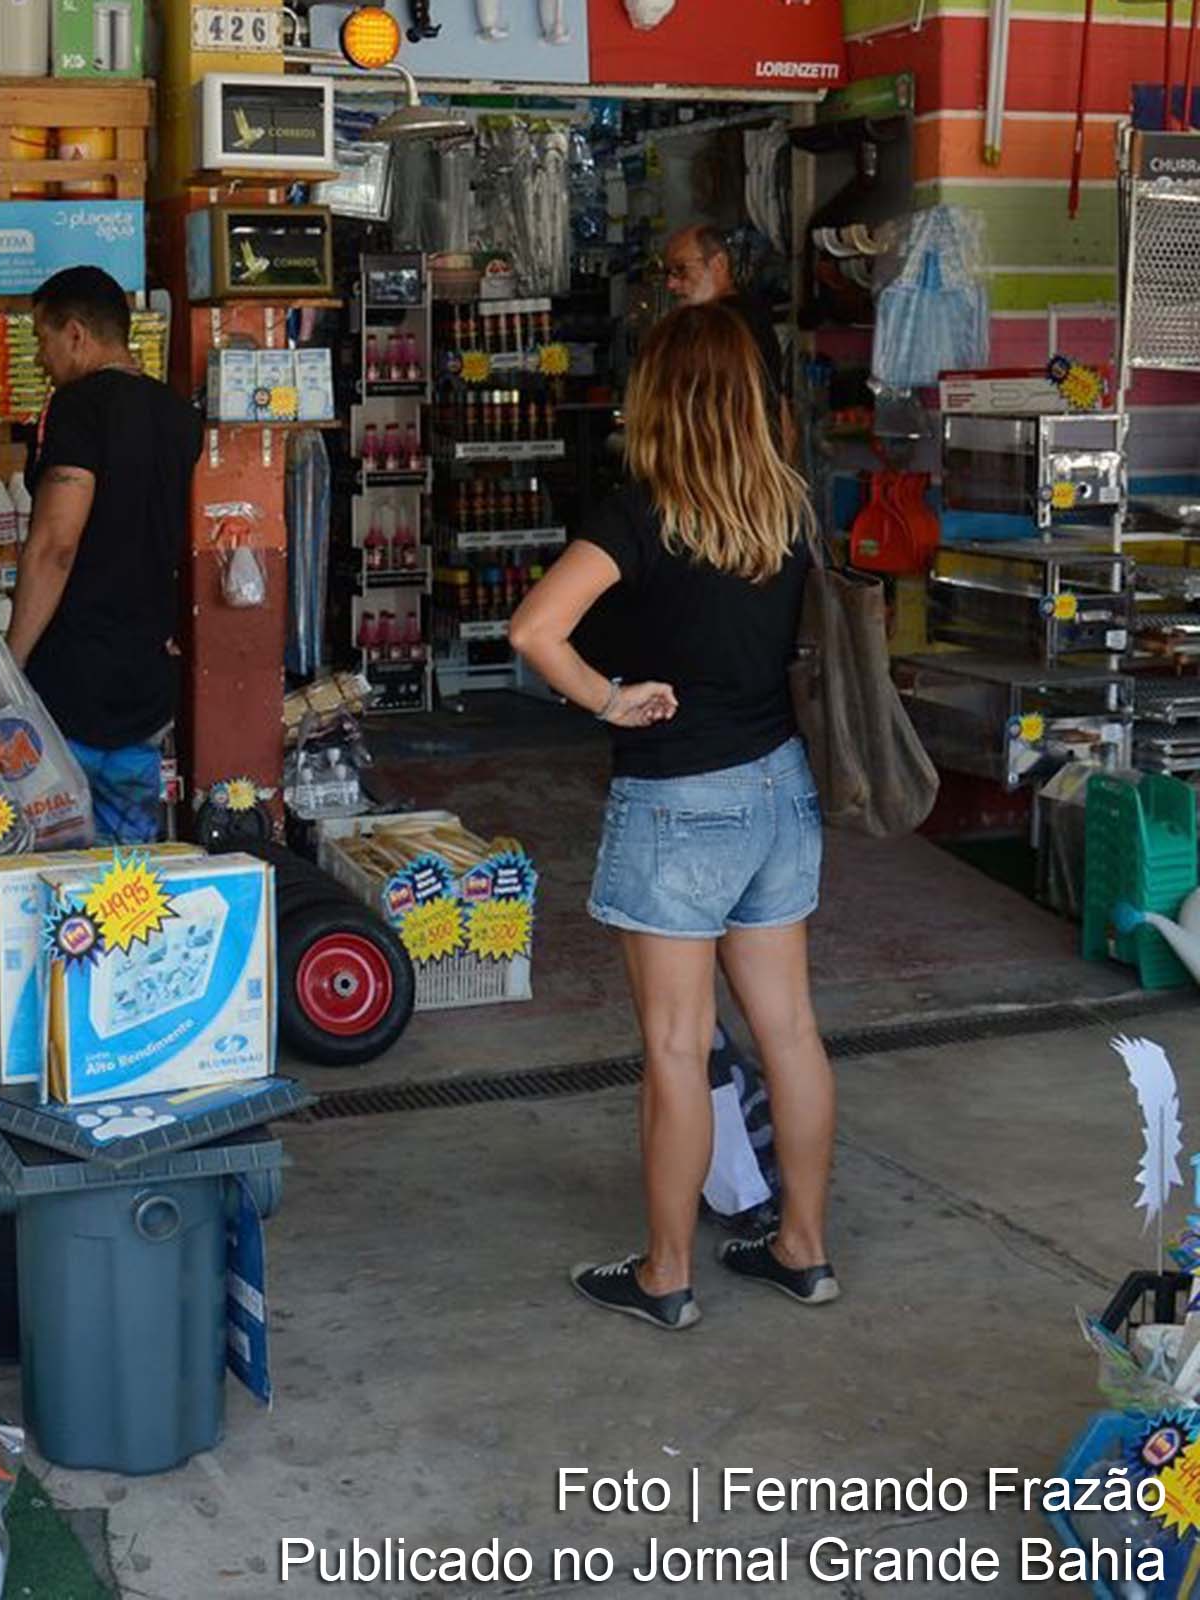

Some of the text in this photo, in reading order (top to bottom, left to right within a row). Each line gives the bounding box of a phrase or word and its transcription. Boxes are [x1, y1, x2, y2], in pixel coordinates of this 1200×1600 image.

[755, 61, 840, 79] LORENZETTI
[267, 127, 317, 139] CORREIOS
[84, 1058, 117, 1076] Alto
